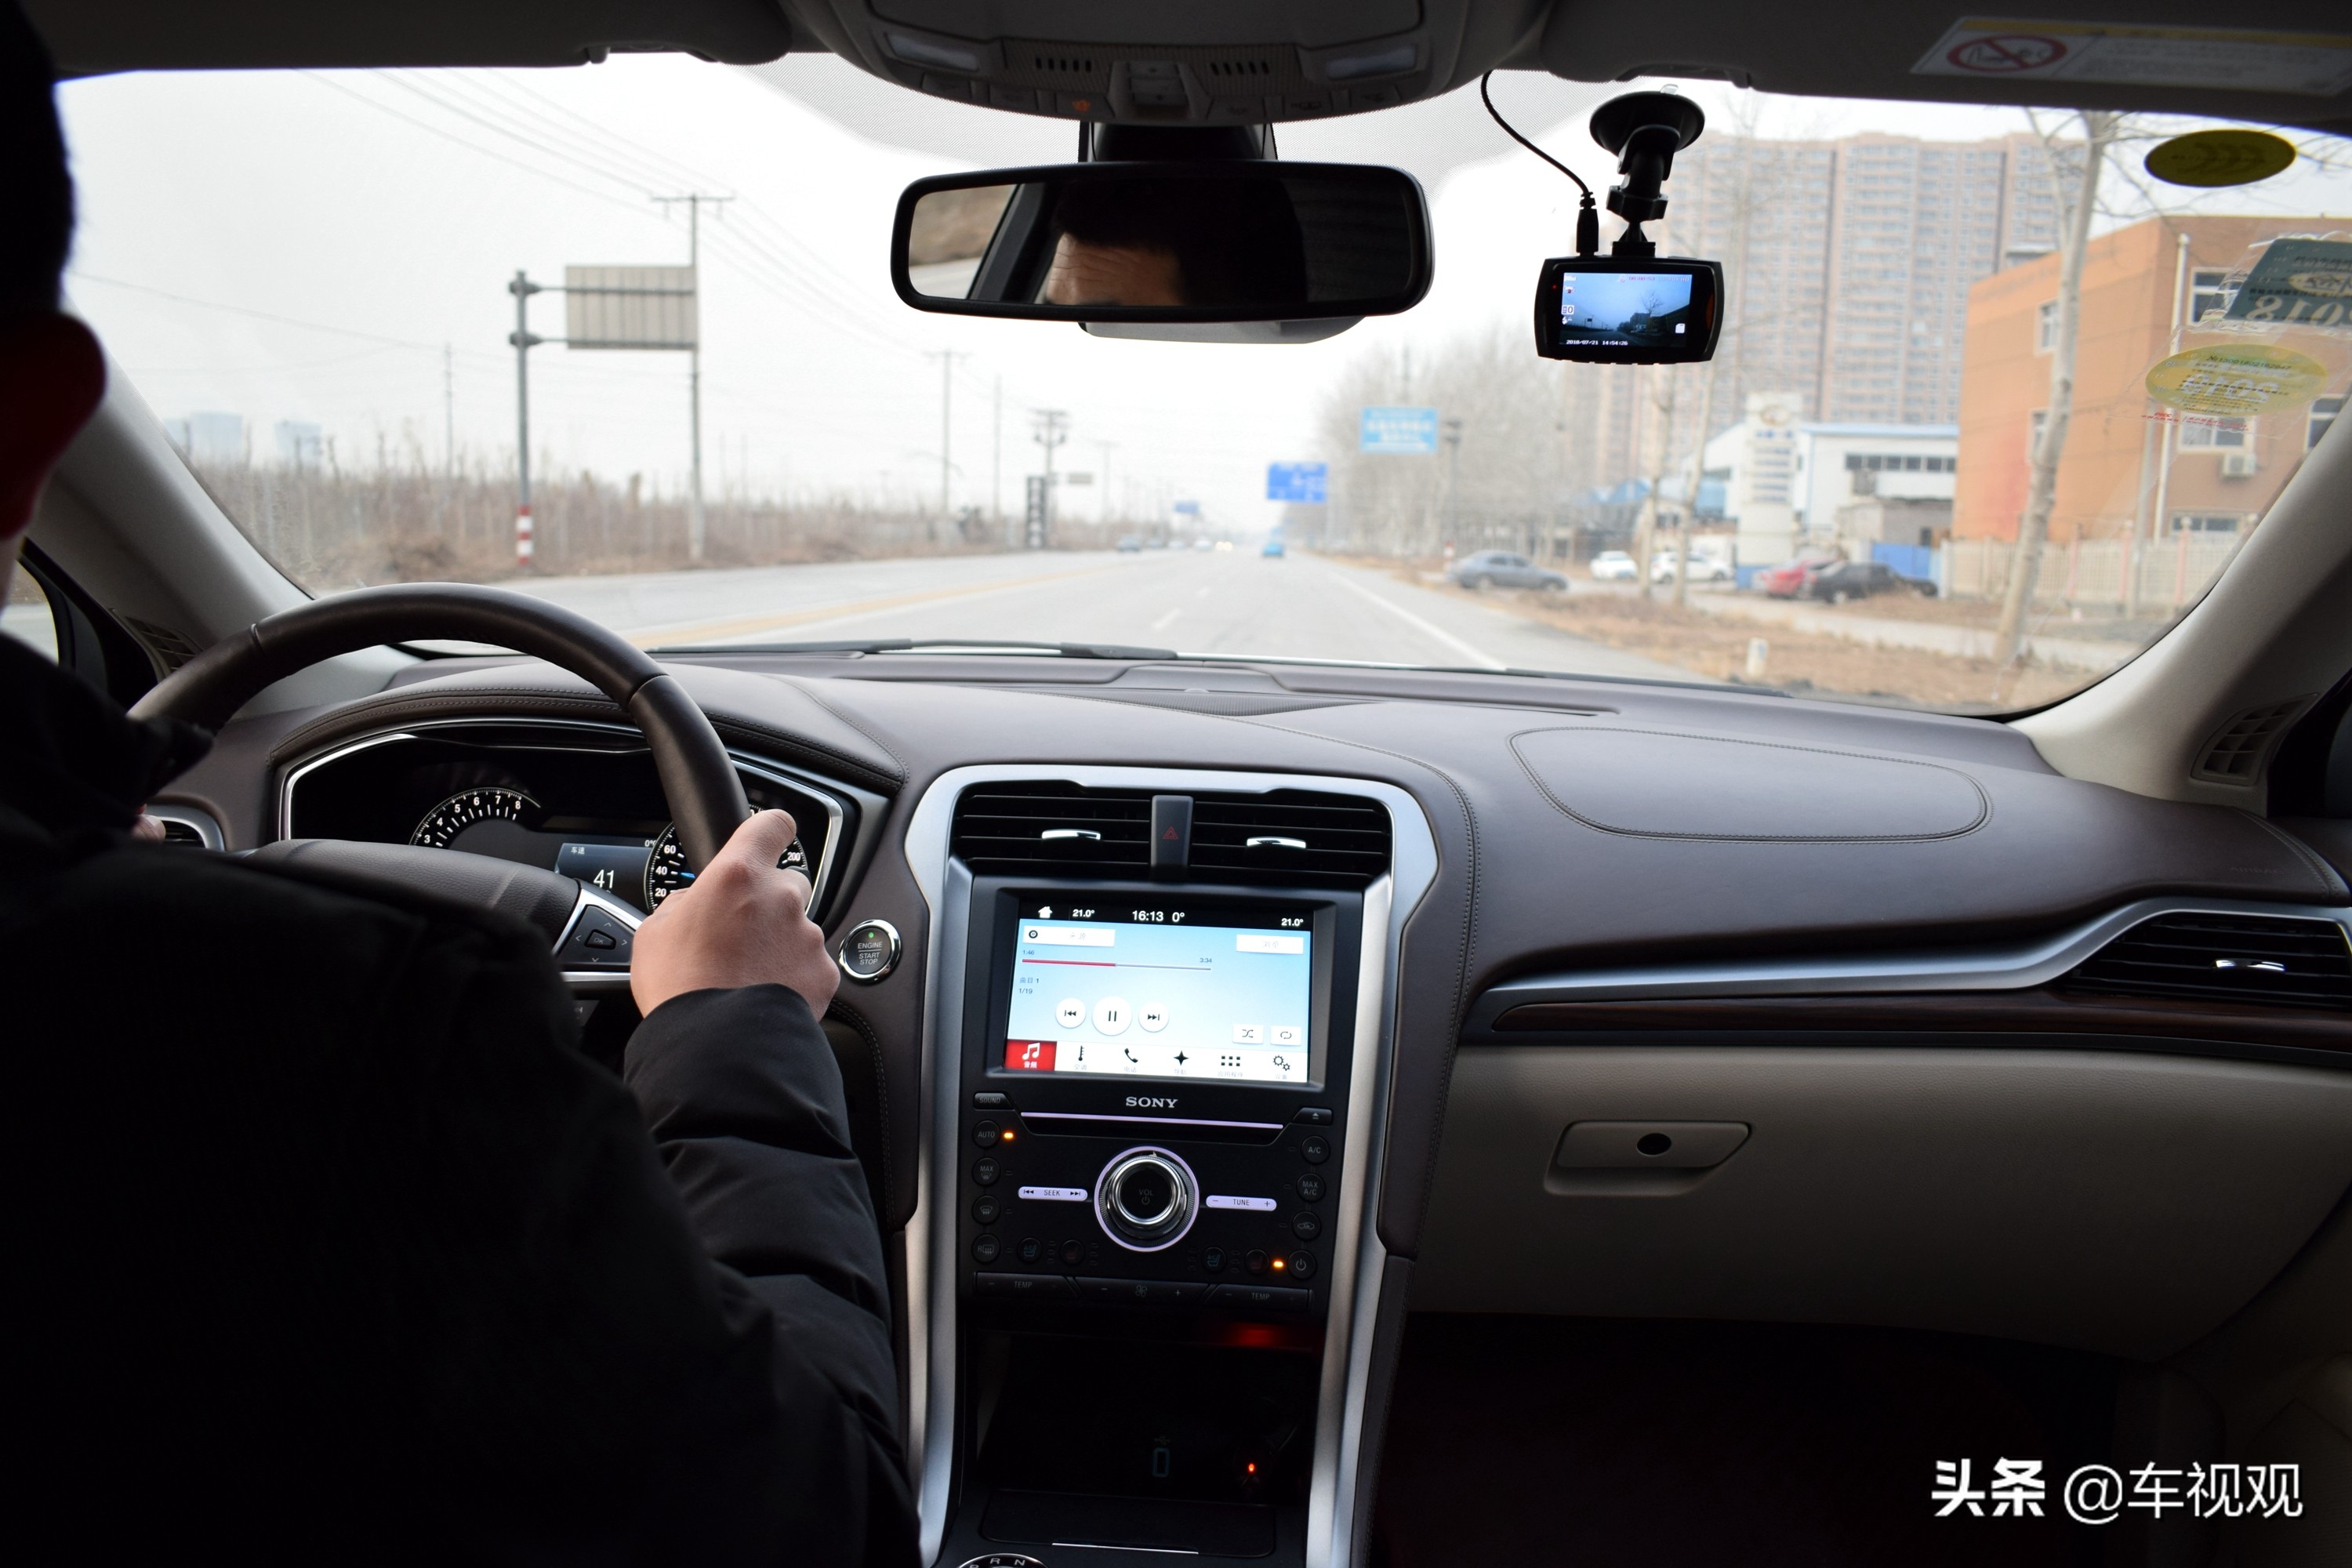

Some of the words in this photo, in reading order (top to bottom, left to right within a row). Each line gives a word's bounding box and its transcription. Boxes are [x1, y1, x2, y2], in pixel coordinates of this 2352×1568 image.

[473, 797, 481, 806] 6
[495, 795, 502, 804] 7
[454, 804, 461, 814] 5
[514, 800, 521, 811] 8
[436, 817, 444, 826] 4
[424, 834, 431, 844] 3
[663, 845, 677, 855] 60
[787, 851, 801, 862] 200
[655, 866, 668, 876] 40
[593, 869, 615, 889] 41
[655, 887, 667, 898] 20
[1131, 909, 1164, 922] 16:13
[1126, 1096, 1178, 1109] SONY
[978, 1131, 996, 1139] AUTO
[1307, 1145, 1322, 1155] A/C
[1302, 1180, 1319, 1189] MAX
[1044, 1189, 1061, 1197] SEEK
[1138, 1188, 1155, 1197] VOL
[1302, 1188, 1318, 1196] A/C
[1232, 1198, 1250, 1207] TUNE
[1014, 1280, 1033, 1290] TEMP
[1251, 1292, 1270, 1301] TEMP
